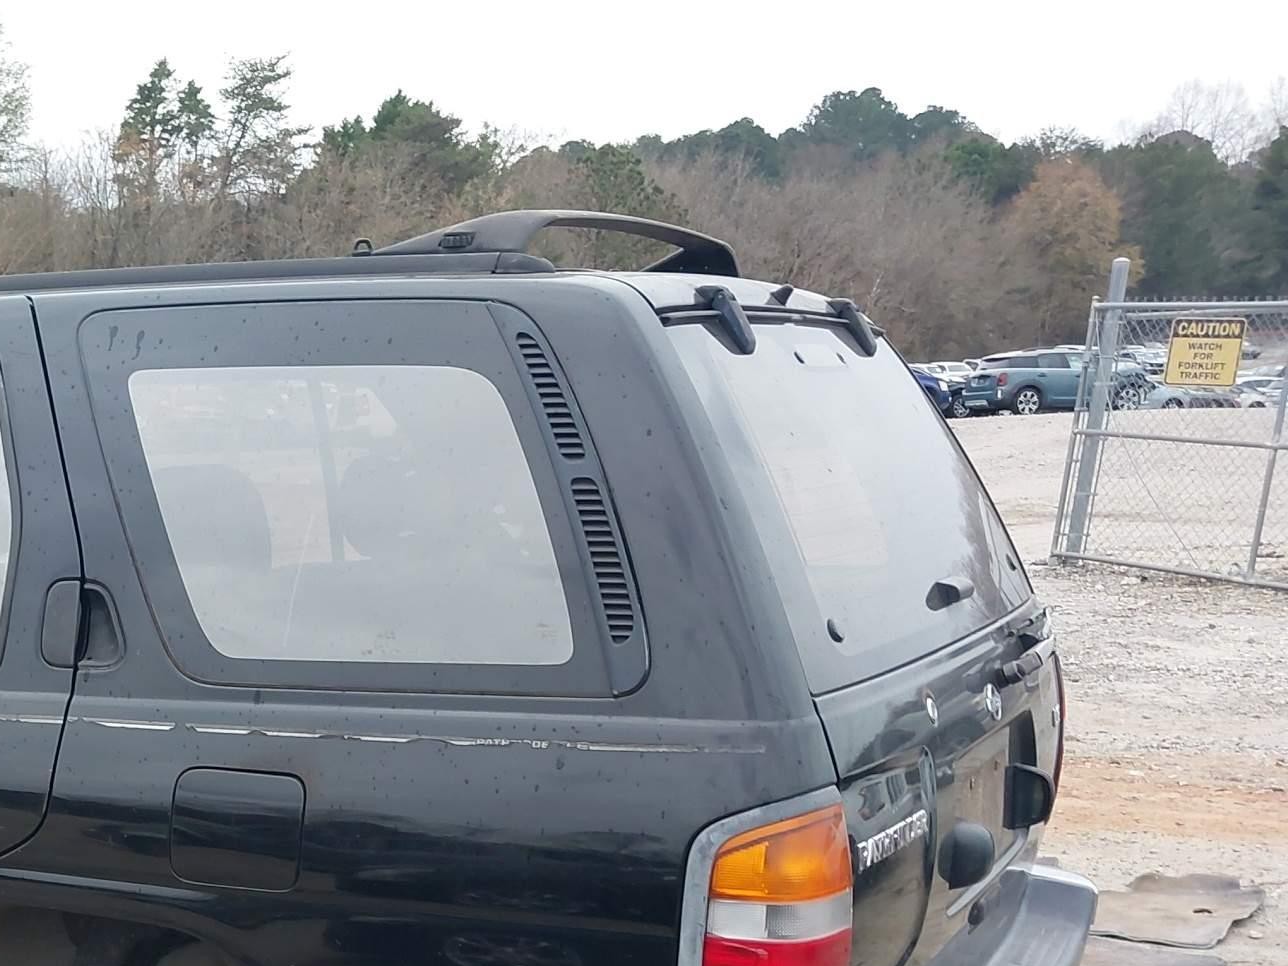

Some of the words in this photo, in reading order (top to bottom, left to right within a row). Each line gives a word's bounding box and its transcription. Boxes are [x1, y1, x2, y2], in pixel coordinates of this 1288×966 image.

[1178, 322, 1241, 335] CAUTION
[1188, 343, 1222, 351] WATCH
[1193, 352, 1213, 360] FOR
[1178, 361, 1226, 371] FORKLIFT
[1180, 371, 1220, 380] TRAFFIC
